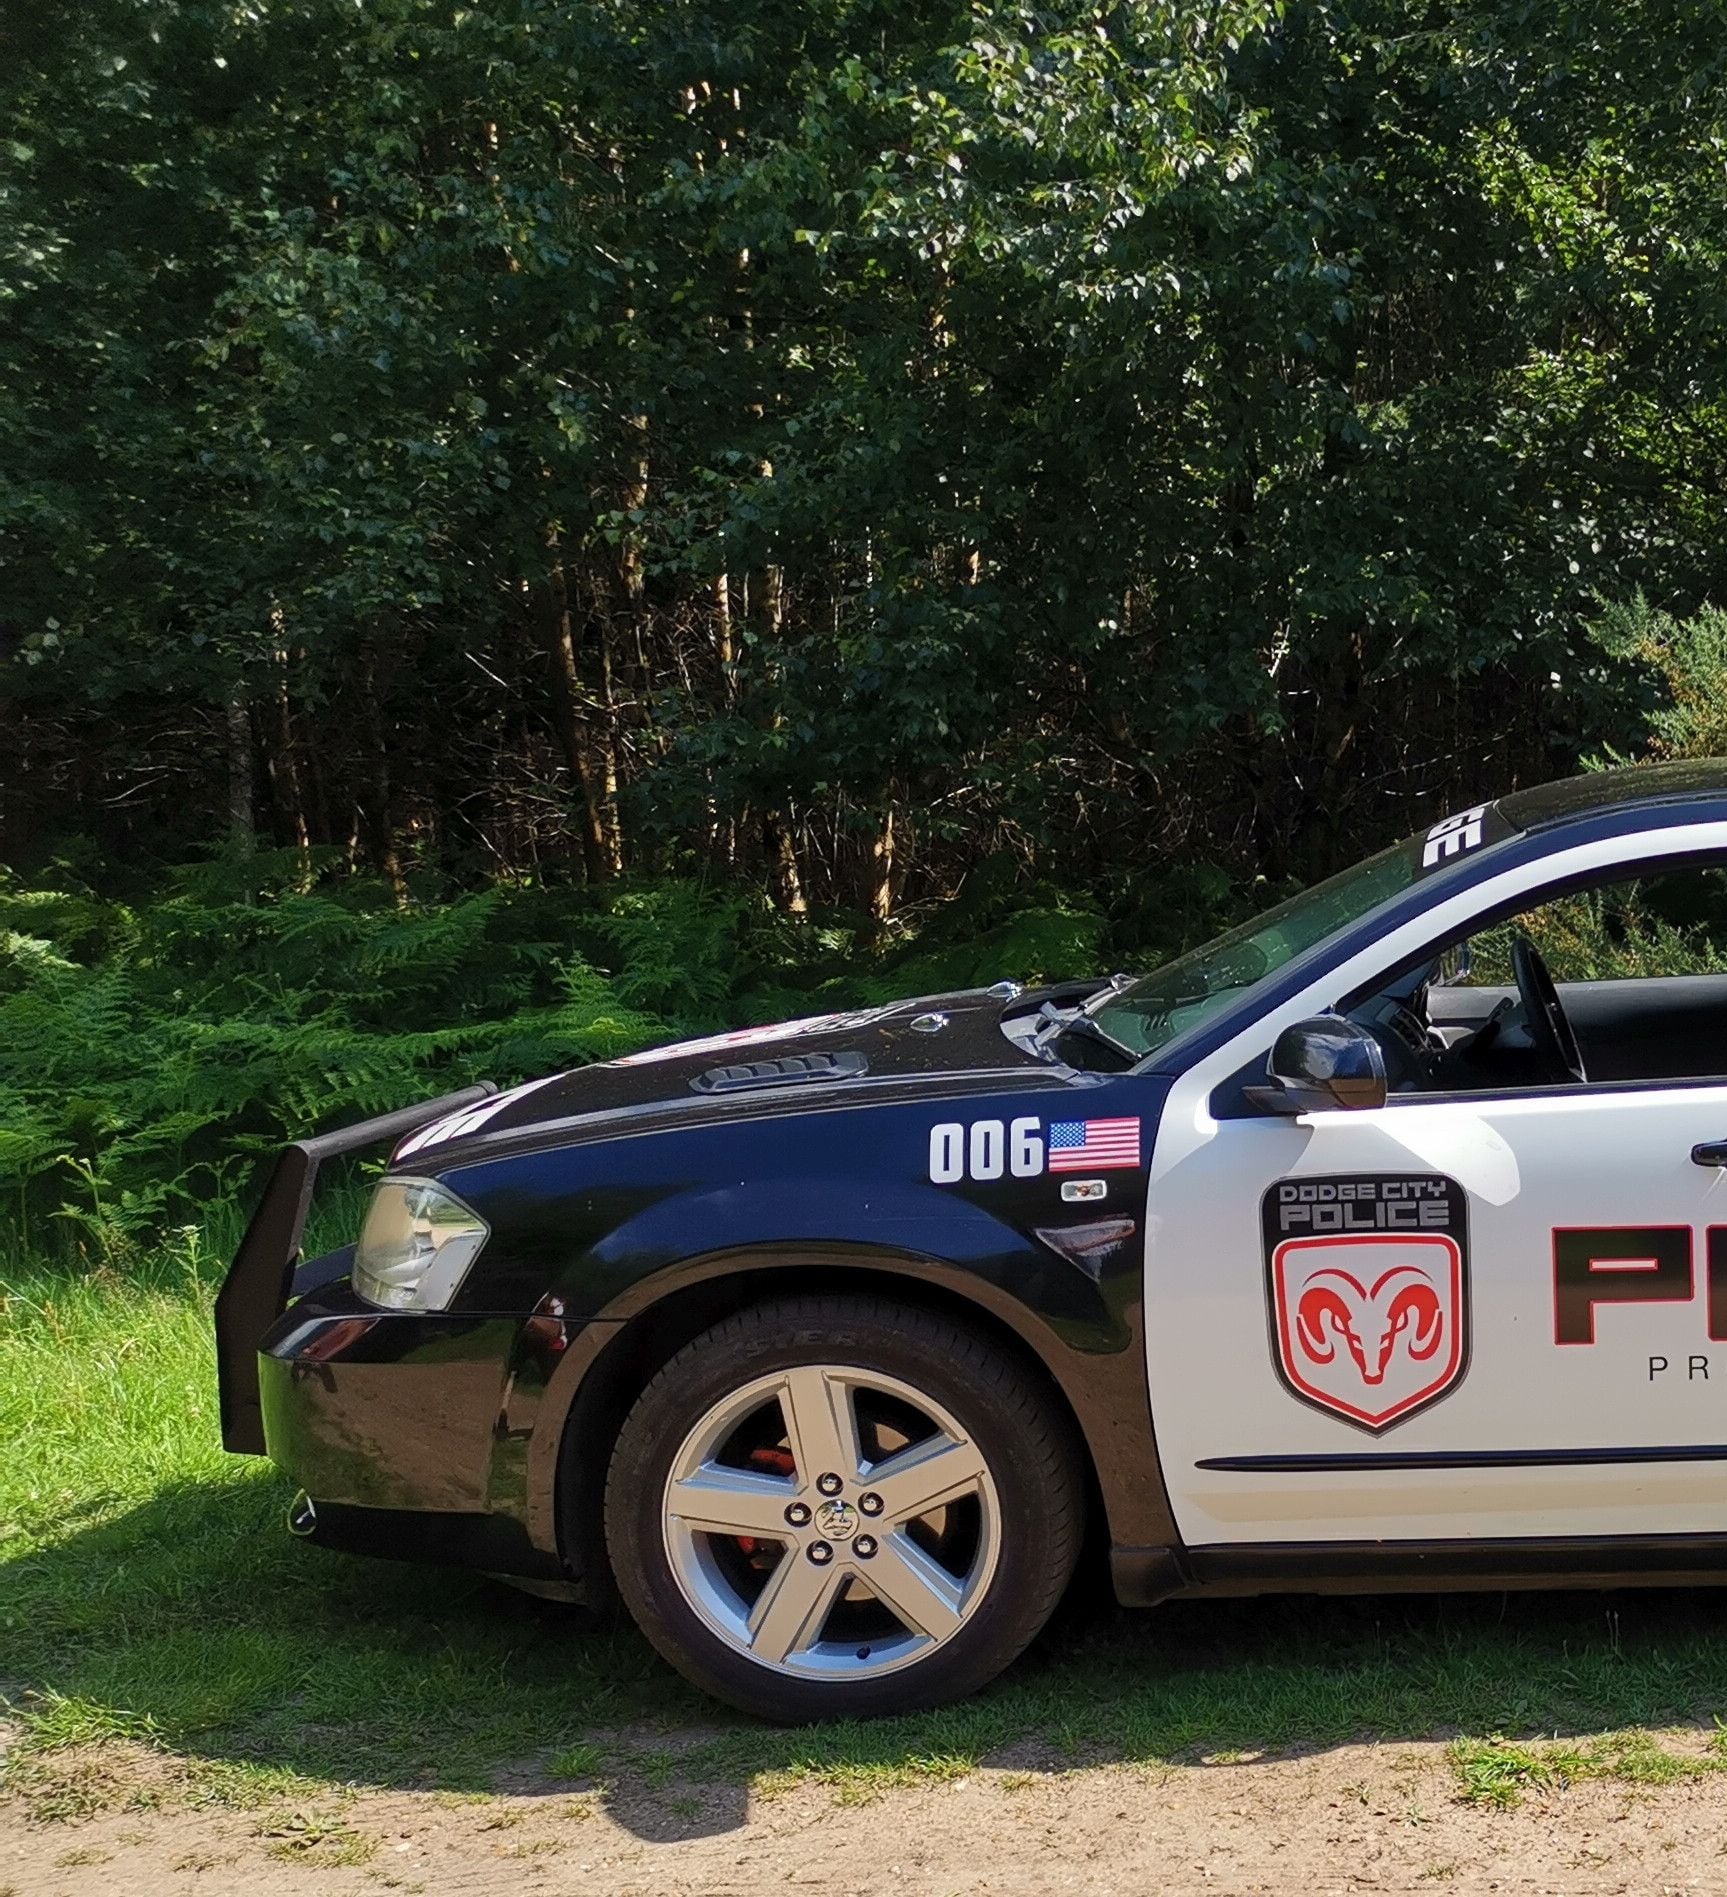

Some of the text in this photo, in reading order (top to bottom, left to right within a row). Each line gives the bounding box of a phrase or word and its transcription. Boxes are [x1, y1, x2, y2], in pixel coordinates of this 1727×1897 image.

[929, 1116, 1044, 1184] 006
[1279, 1180, 1447, 1202] DODGE CITY
[1279, 1200, 1450, 1231] POLICE
